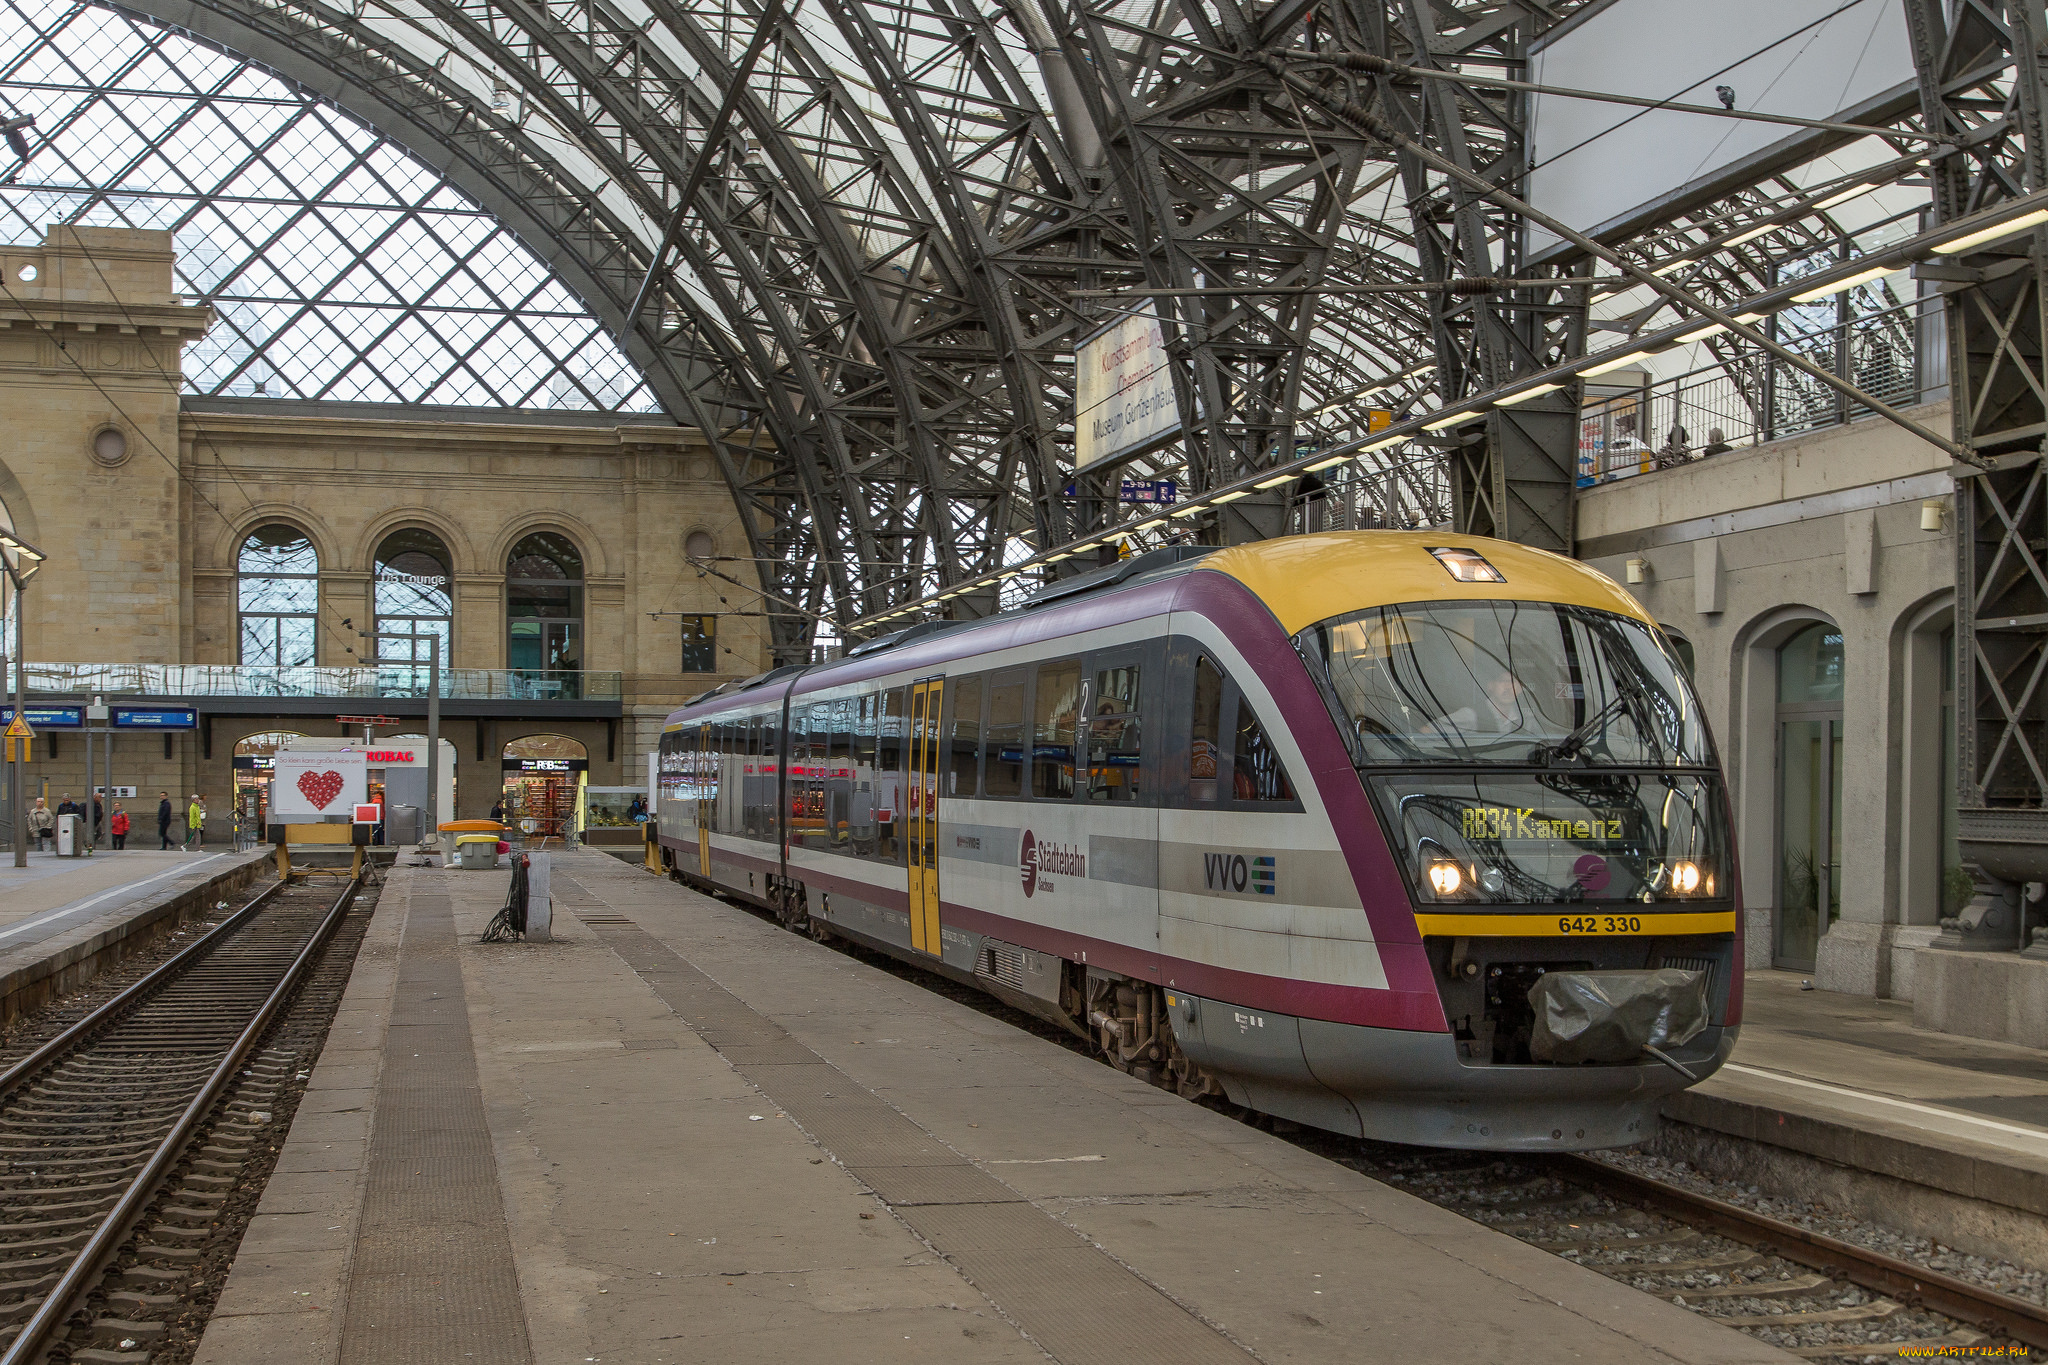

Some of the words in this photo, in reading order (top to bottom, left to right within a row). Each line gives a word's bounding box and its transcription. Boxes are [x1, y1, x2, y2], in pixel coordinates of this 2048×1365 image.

[1117, 361, 1154, 396] Chemnitz
[1093, 412, 1123, 441] Museum
[402, 574, 446, 587] Lounge
[1081, 682, 1088, 721] 2
[2, 710, 13, 719] 10
[187, 713, 193, 721] 9
[317, 757, 334, 765] große
[366, 751, 414, 761] ROBAG
[1462, 808, 1512, 839] RB34
[1516, 808, 1622, 839] Kamenz
[1038, 840, 1086, 878] Städtebahn
[1204, 852, 1247, 893] VVO
[1038, 877, 1055, 893] Sachsen
[1559, 917, 1597, 933] 642
[1603, 917, 1641, 933] 330
